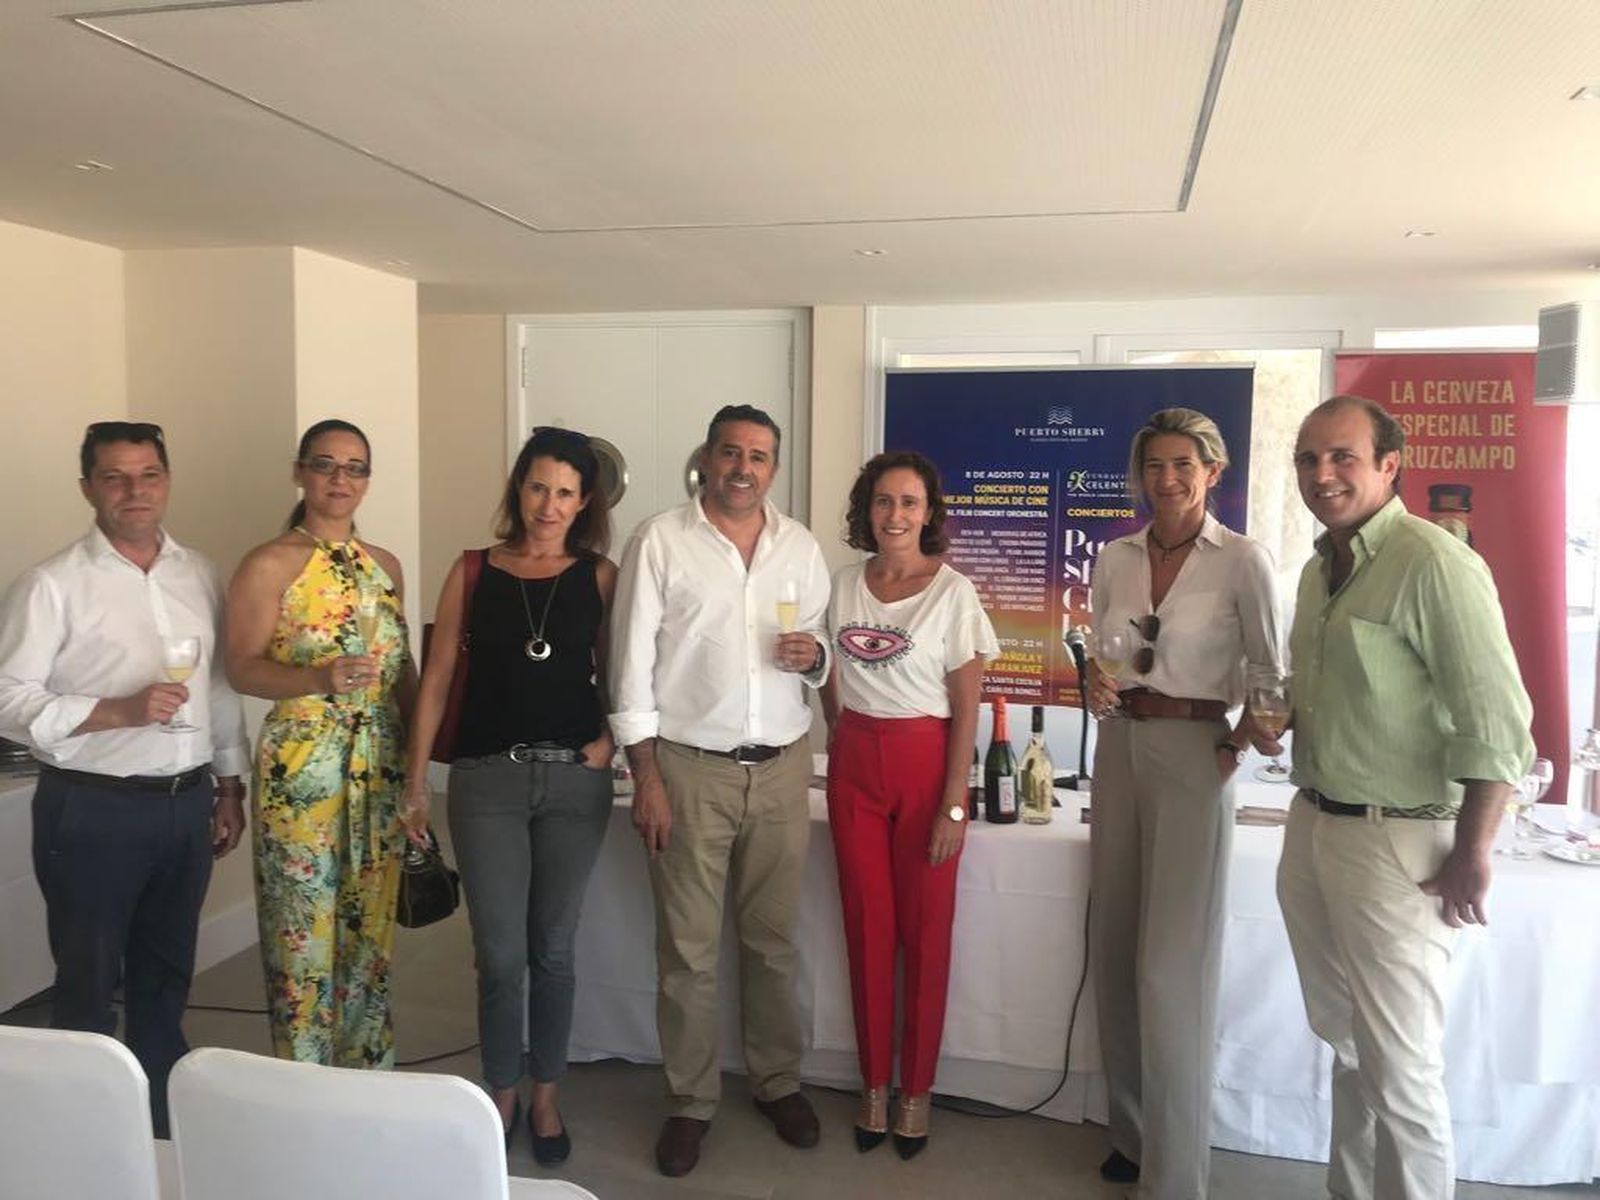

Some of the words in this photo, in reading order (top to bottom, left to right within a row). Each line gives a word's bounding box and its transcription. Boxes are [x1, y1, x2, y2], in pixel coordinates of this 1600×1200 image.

[1391, 380, 1416, 404] LA
[1423, 380, 1516, 404] CERVEZA
[1491, 414, 1516, 437] DE
[1014, 427, 1059, 437] PUERTO
[1061, 427, 1105, 437] SHERRY
[1402, 445, 1516, 470] RUZCAMPO
[973, 471, 985, 479] DE
[987, 471, 1024, 479] AGOSTO
[1029, 471, 1040, 479] 22
[973, 484, 1026, 494] CONCIERTO
[1028, 485, 1049, 495] CON
[1011, 496, 1025, 506] DE
[1025, 496, 1049, 506] CINE
[1066, 508, 1136, 518] CONCIERTOS
